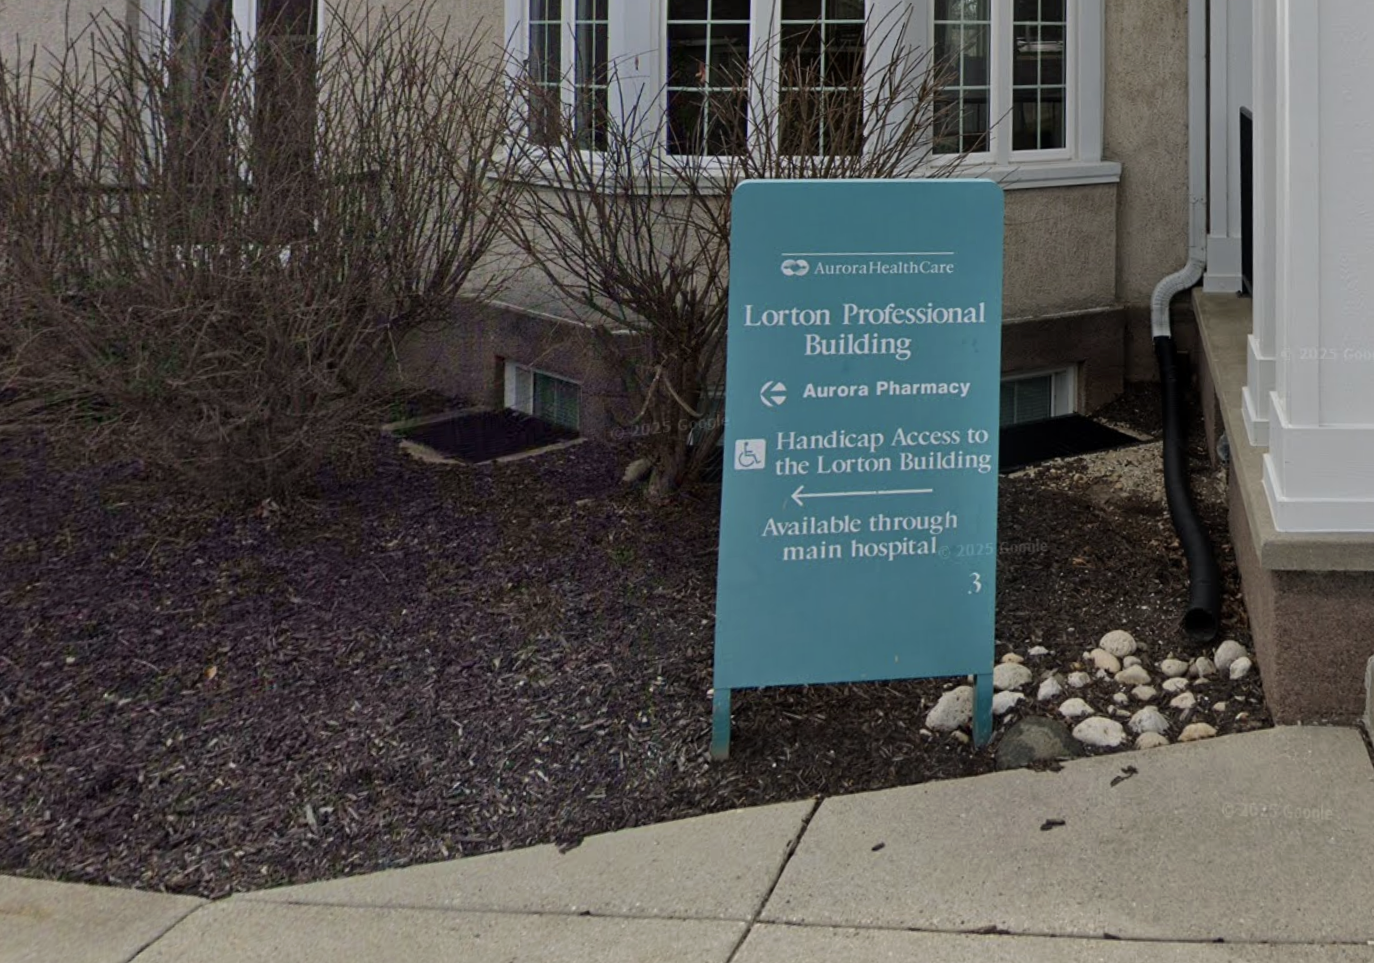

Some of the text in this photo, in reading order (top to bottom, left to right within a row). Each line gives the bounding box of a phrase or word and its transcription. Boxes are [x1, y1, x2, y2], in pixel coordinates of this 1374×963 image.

[744, 301, 986, 327] Lorton Professional
[804, 332, 912, 361] Building
[802, 380, 971, 398] Aurora Pharmacy
[776, 427, 989, 453] Handicap Access to
[775, 450, 992, 476] the Lorton Building
[761, 510, 958, 537] Available through
[783, 536, 938, 562] main hospital
[967, 571, 983, 595] 3
